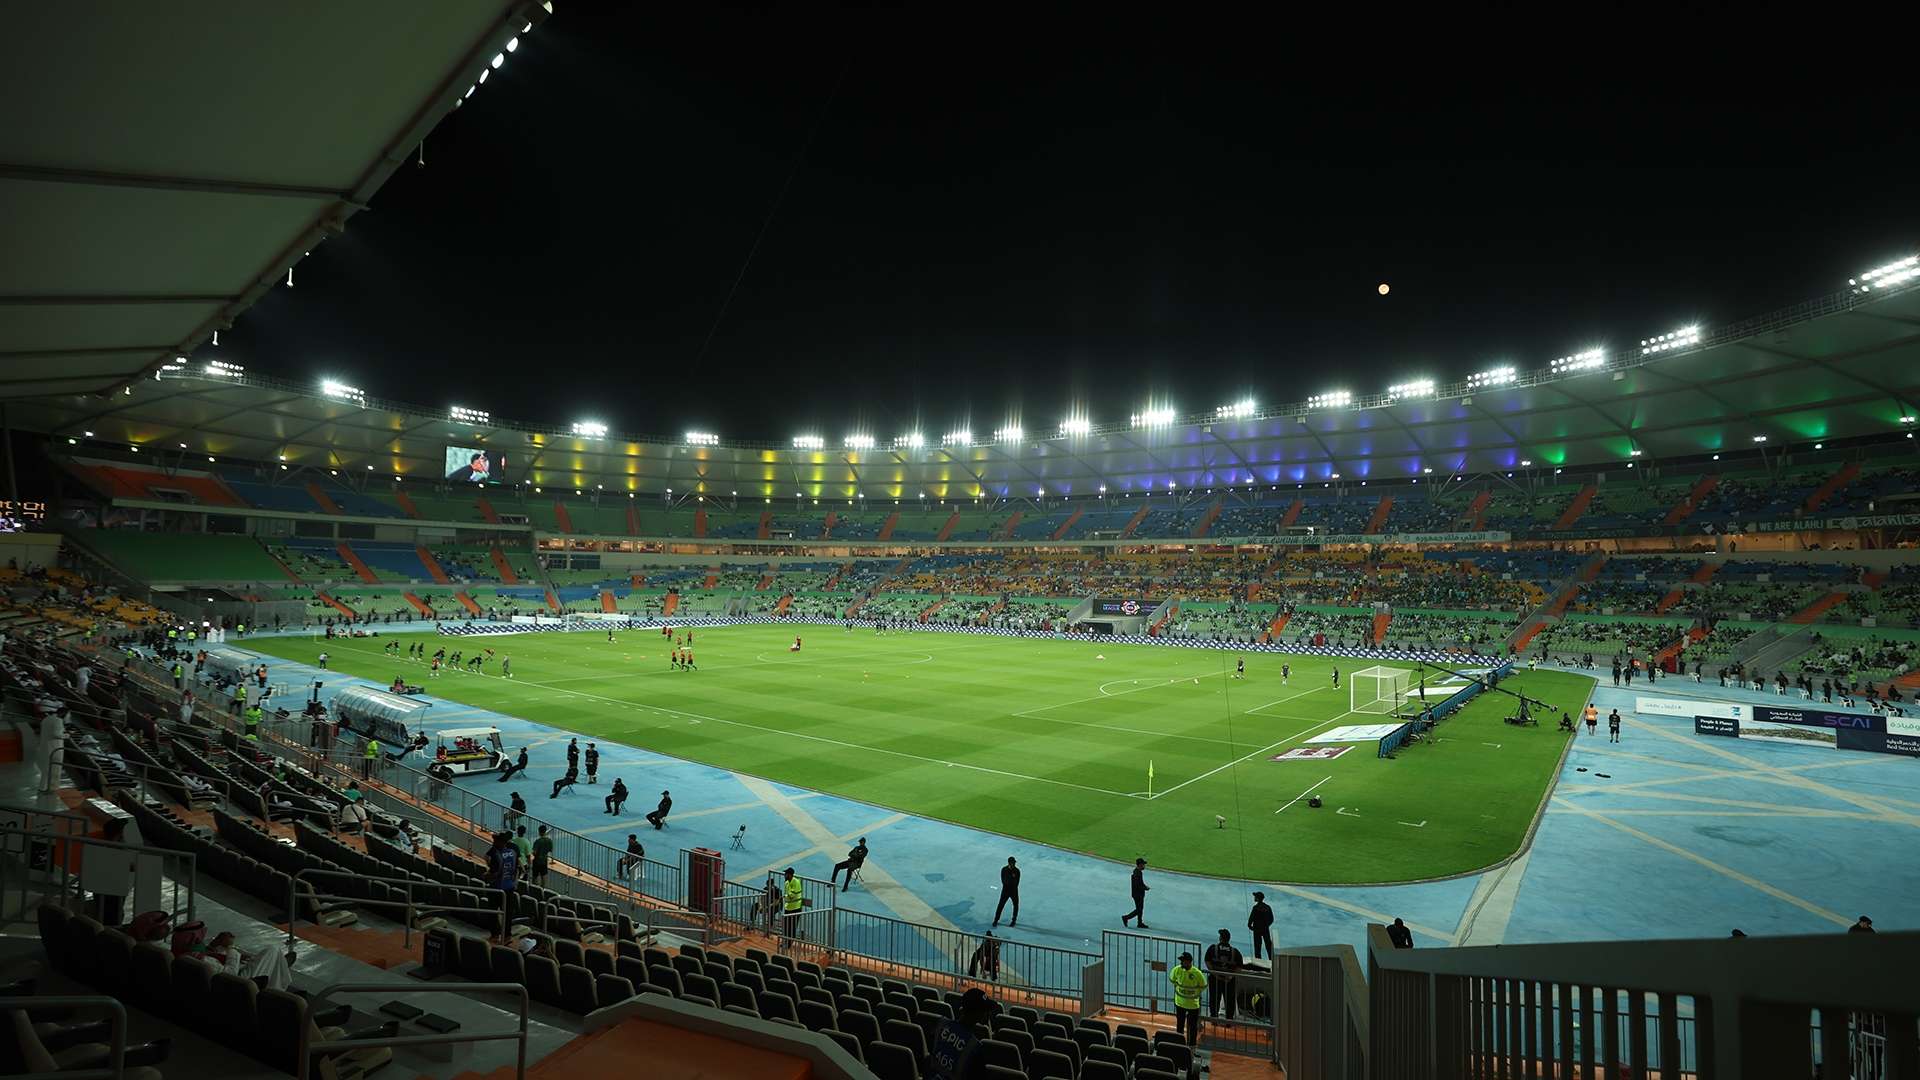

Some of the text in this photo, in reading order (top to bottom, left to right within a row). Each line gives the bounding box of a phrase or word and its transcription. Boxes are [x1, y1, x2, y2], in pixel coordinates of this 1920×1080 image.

[1759, 522, 1773, 531] WE
[1775, 521, 1792, 530] ARE
[1824, 715, 1870, 728] SCAI
